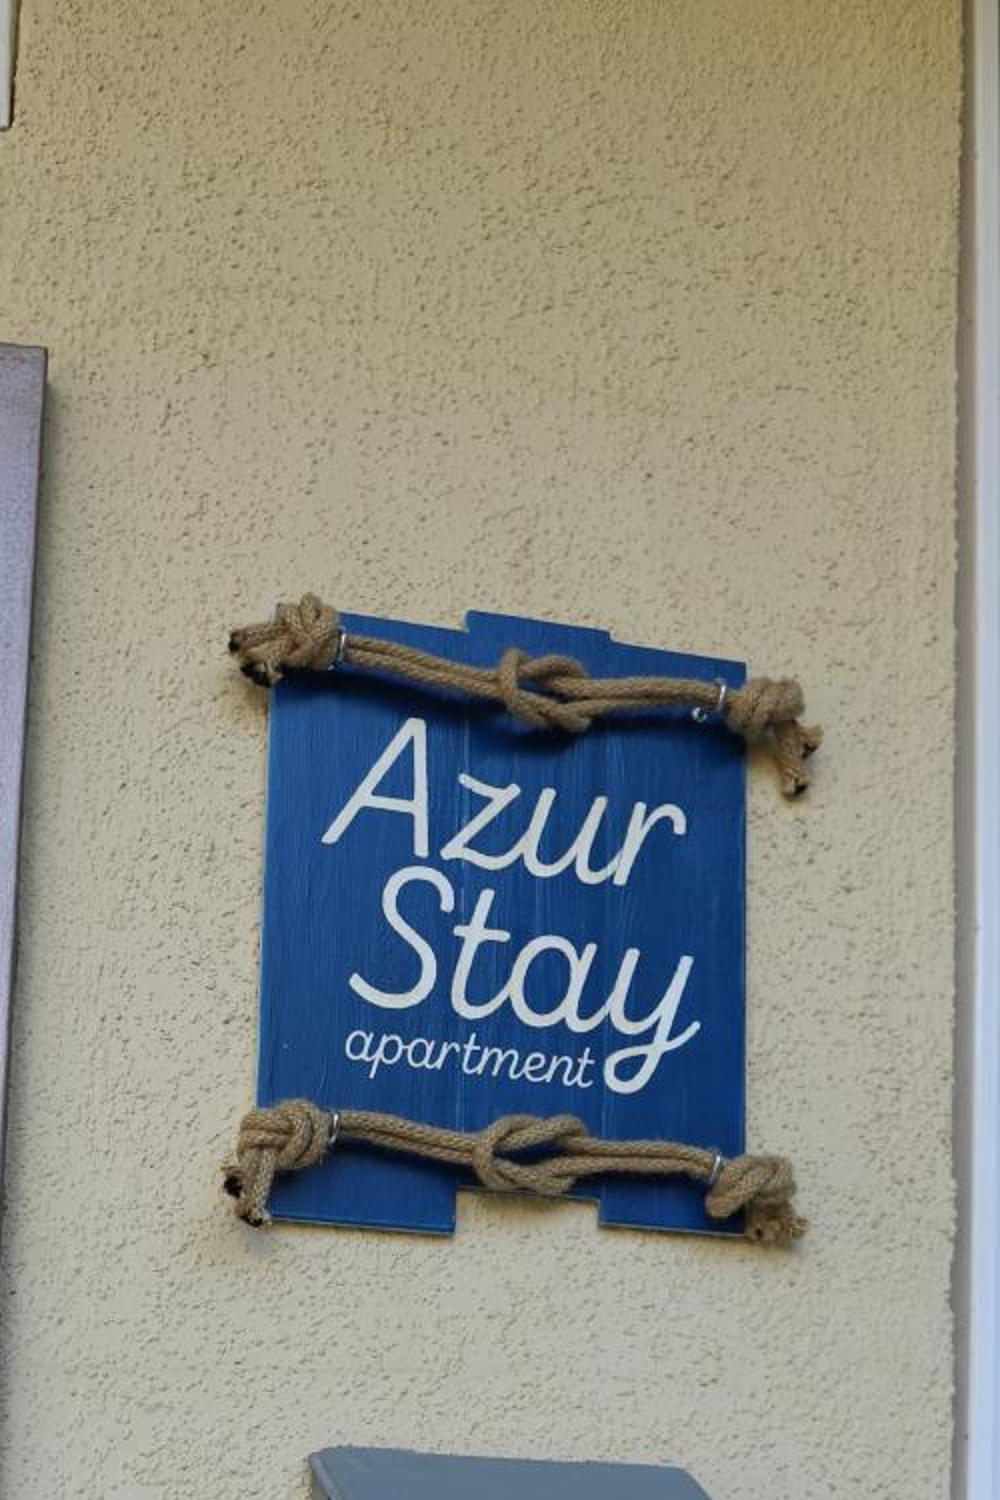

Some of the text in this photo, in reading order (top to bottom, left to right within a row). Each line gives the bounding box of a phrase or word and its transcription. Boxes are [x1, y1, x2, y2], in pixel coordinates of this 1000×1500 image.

[321, 717, 687, 887] Azur
[344, 1027, 595, 1089] apartment
[348, 865, 701, 1095] Stay
